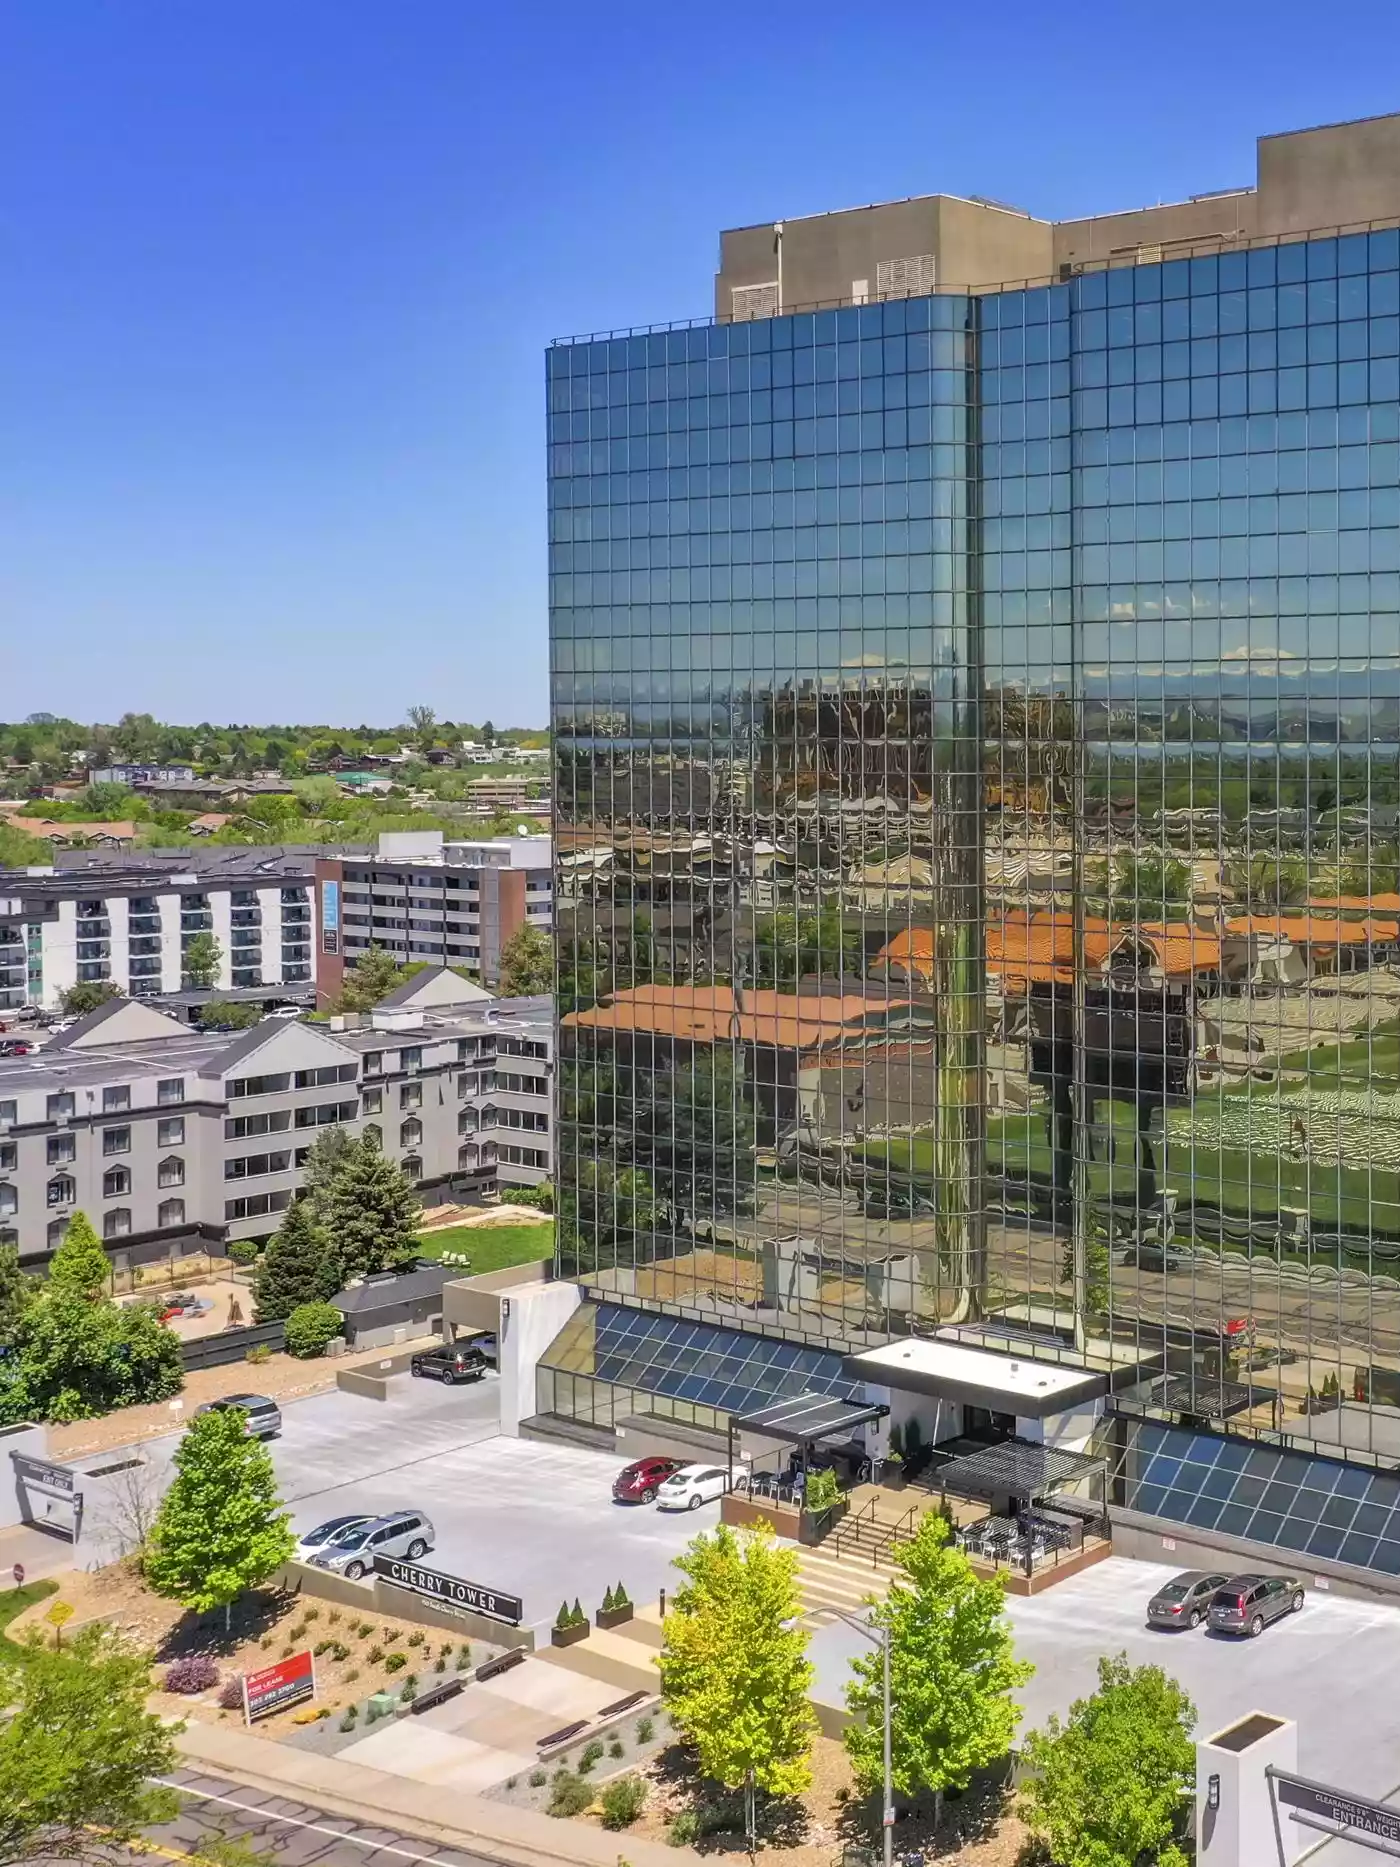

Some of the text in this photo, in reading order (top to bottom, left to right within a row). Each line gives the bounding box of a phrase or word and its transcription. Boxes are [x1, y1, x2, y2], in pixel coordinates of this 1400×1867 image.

[392, 1564, 495, 1610] CHERRY TOWER
[1315, 1793, 1356, 1814] CLEARANCE
[1332, 1806, 1399, 1840] ENTRANCE
